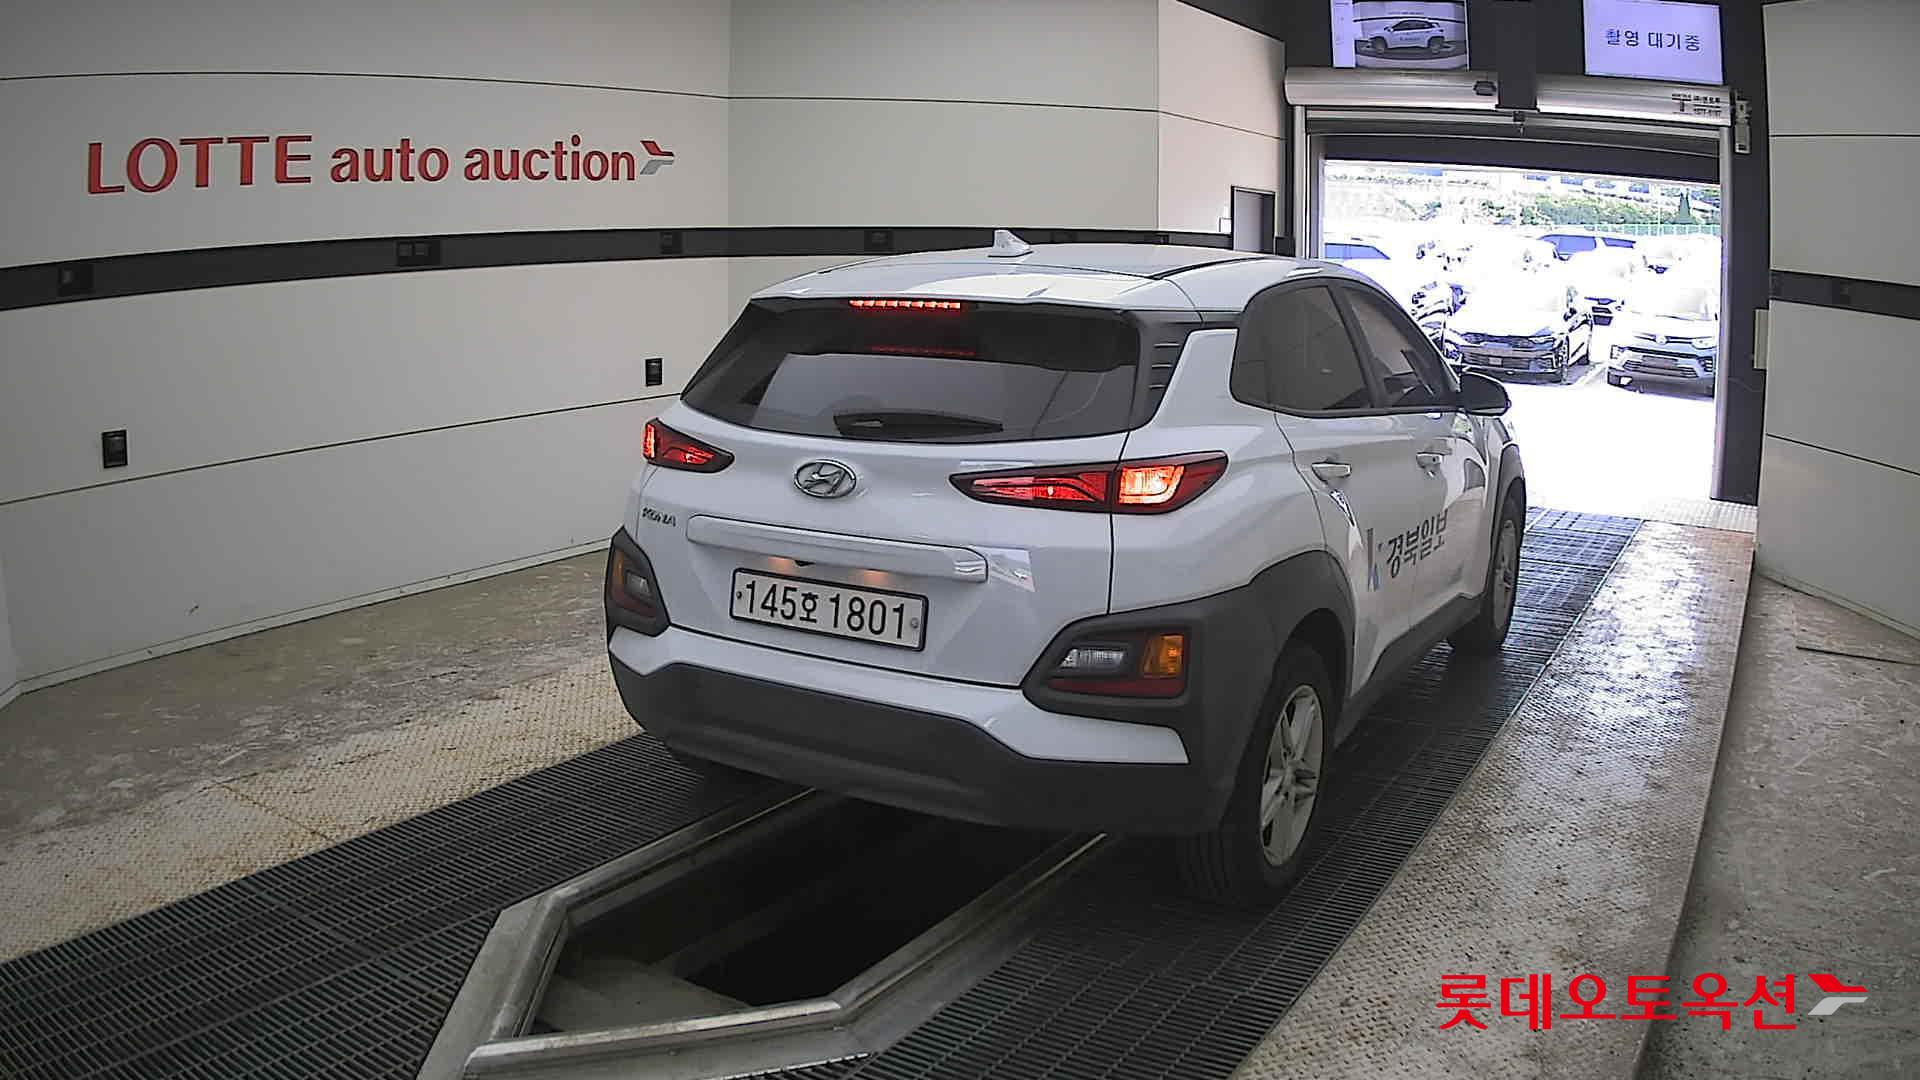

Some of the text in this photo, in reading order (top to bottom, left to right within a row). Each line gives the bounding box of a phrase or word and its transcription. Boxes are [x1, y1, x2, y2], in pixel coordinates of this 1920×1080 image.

[87, 134, 637, 195] LOTTE auto auction
[1386, 508, 1448, 579] 경북일보
